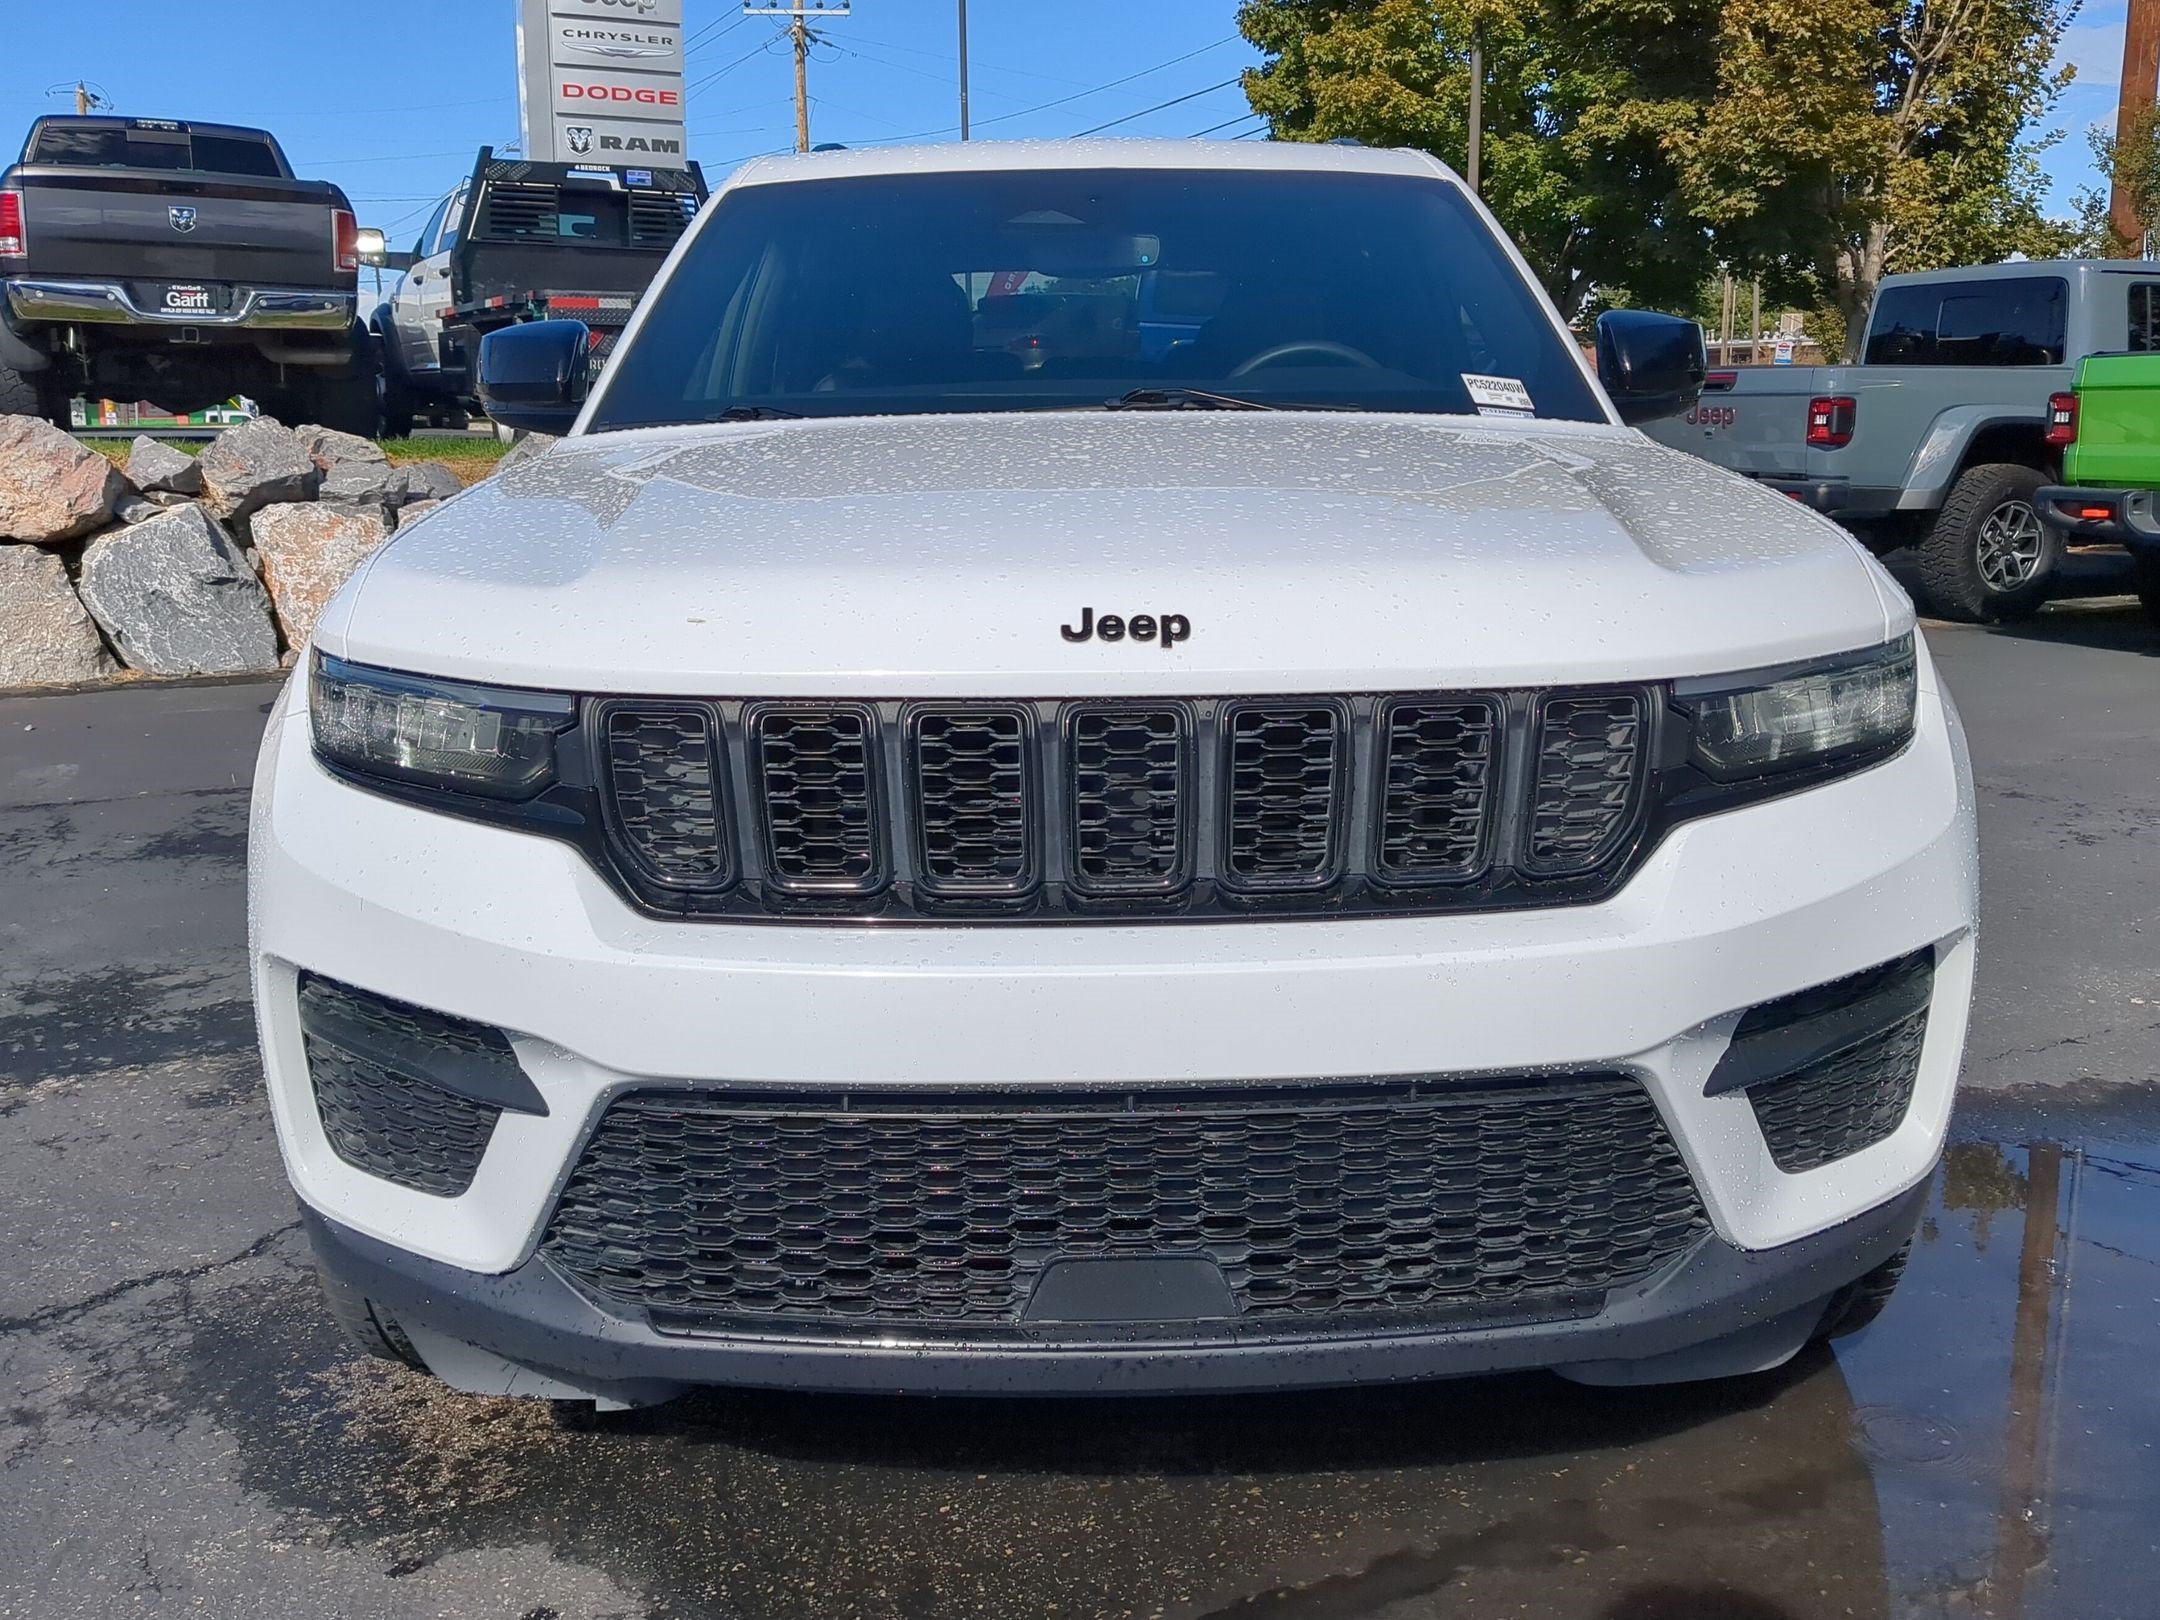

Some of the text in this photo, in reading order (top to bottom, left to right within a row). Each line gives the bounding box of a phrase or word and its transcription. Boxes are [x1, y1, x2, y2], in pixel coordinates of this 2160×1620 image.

[562, 29, 673, 46] CHRYSLER
[562, 84, 678, 105] DODGE
[600, 135, 680, 154] RAM
[166, 291, 209, 307] Garff
[1687, 402, 1736, 430] Jeep
[1061, 607, 1191, 648] Jeep
